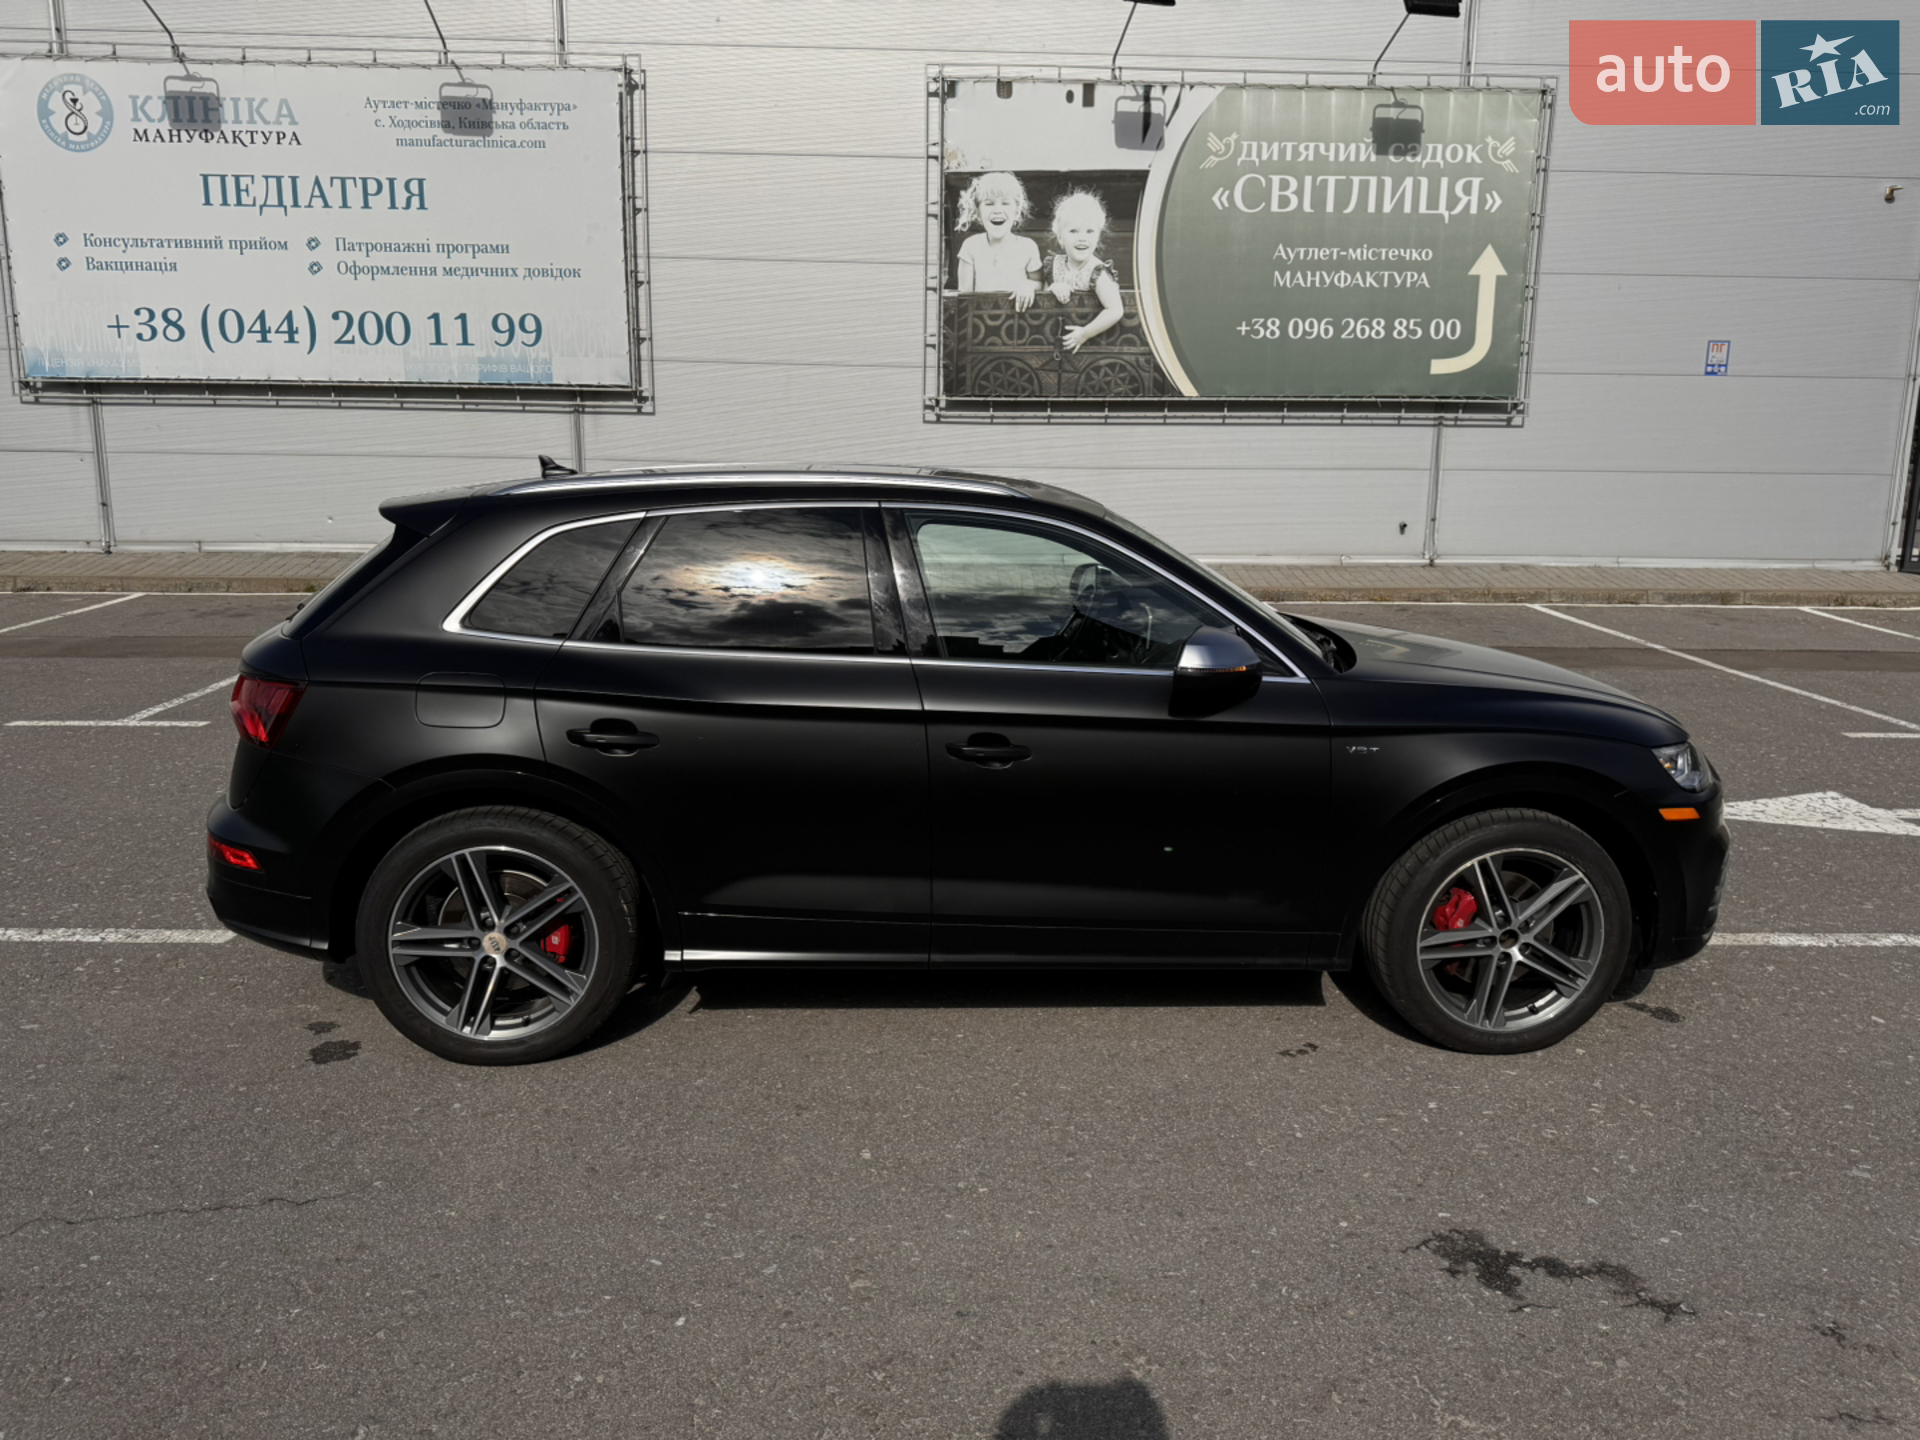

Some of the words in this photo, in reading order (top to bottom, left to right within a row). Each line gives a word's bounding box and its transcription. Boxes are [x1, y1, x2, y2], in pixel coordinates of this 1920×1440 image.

[128, 94, 299, 126] КЛІНІКА
[363, 97, 472, 113] Аутлет-містечко
[475, 98, 578, 116] «Мануфактура»
[388, 115, 456, 131] Ходосівка,
[458, 116, 517, 130] Київська
[519, 116, 570, 131] область
[132, 127, 303, 148] МАНУФАКТУРА
[395, 135, 547, 149] manufacturaclinica.com
[199, 173, 429, 216] ПЕДІАТРІЯ
[1211, 173, 1502, 224] «СВІТЛИЦЯ»
[82, 232, 224, 253] Консультативний
[228, 236, 289, 255] прийом
[334, 237, 431, 257] Патронажні
[436, 241, 510, 259] програми
[1273, 243, 1433, 264] Аутлет-містечко
[85, 256, 178, 275] Вакцинація
[337, 260, 438, 281] Оформлення
[442, 265, 519, 280] медичних
[522, 262, 582, 281] довідок
[1273, 270, 1431, 289] МАНУФАКТУРА
[106, 306, 186, 342] +38
[200, 303, 317, 355] (044)
[331, 310, 411, 346] 200
[426, 312, 475, 347] 11
[491, 312, 543, 348] 99
[1236, 318, 1281, 339] +38
[1288, 318, 1334, 339] 096
[1341, 318, 1386, 339] 268
[1392, 318, 1423, 339] 85
[1429, 318, 1461, 340] 00
